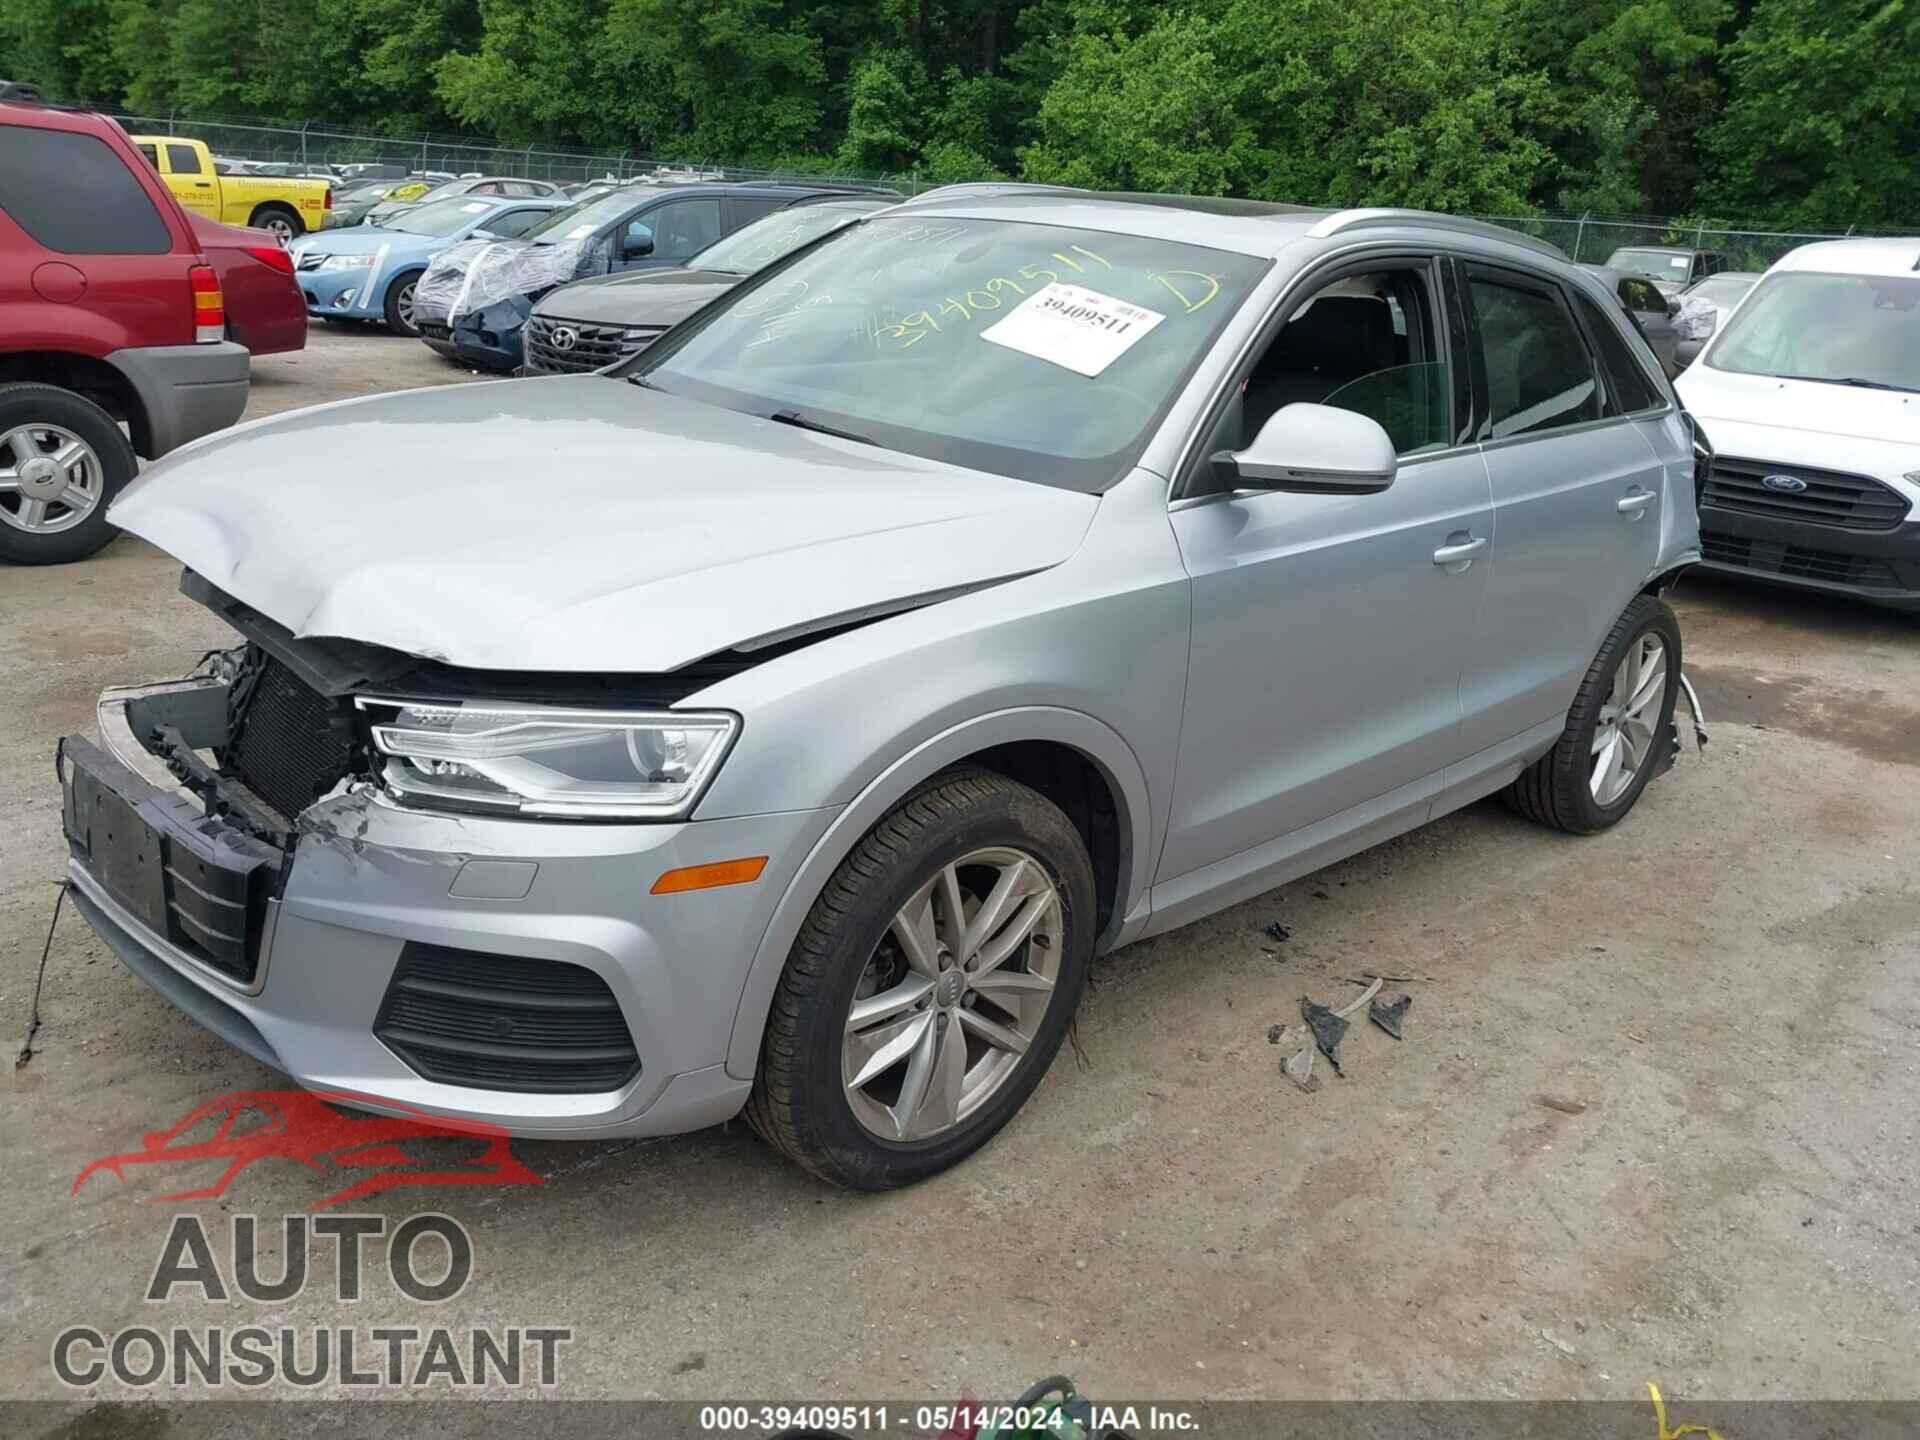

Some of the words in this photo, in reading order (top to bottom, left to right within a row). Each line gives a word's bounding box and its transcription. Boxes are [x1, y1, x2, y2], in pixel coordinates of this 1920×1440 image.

[873, 245, 1112, 348] 39409511
[1148, 270, 1218, 313] D
[1035, 297, 1132, 334] 39409511
